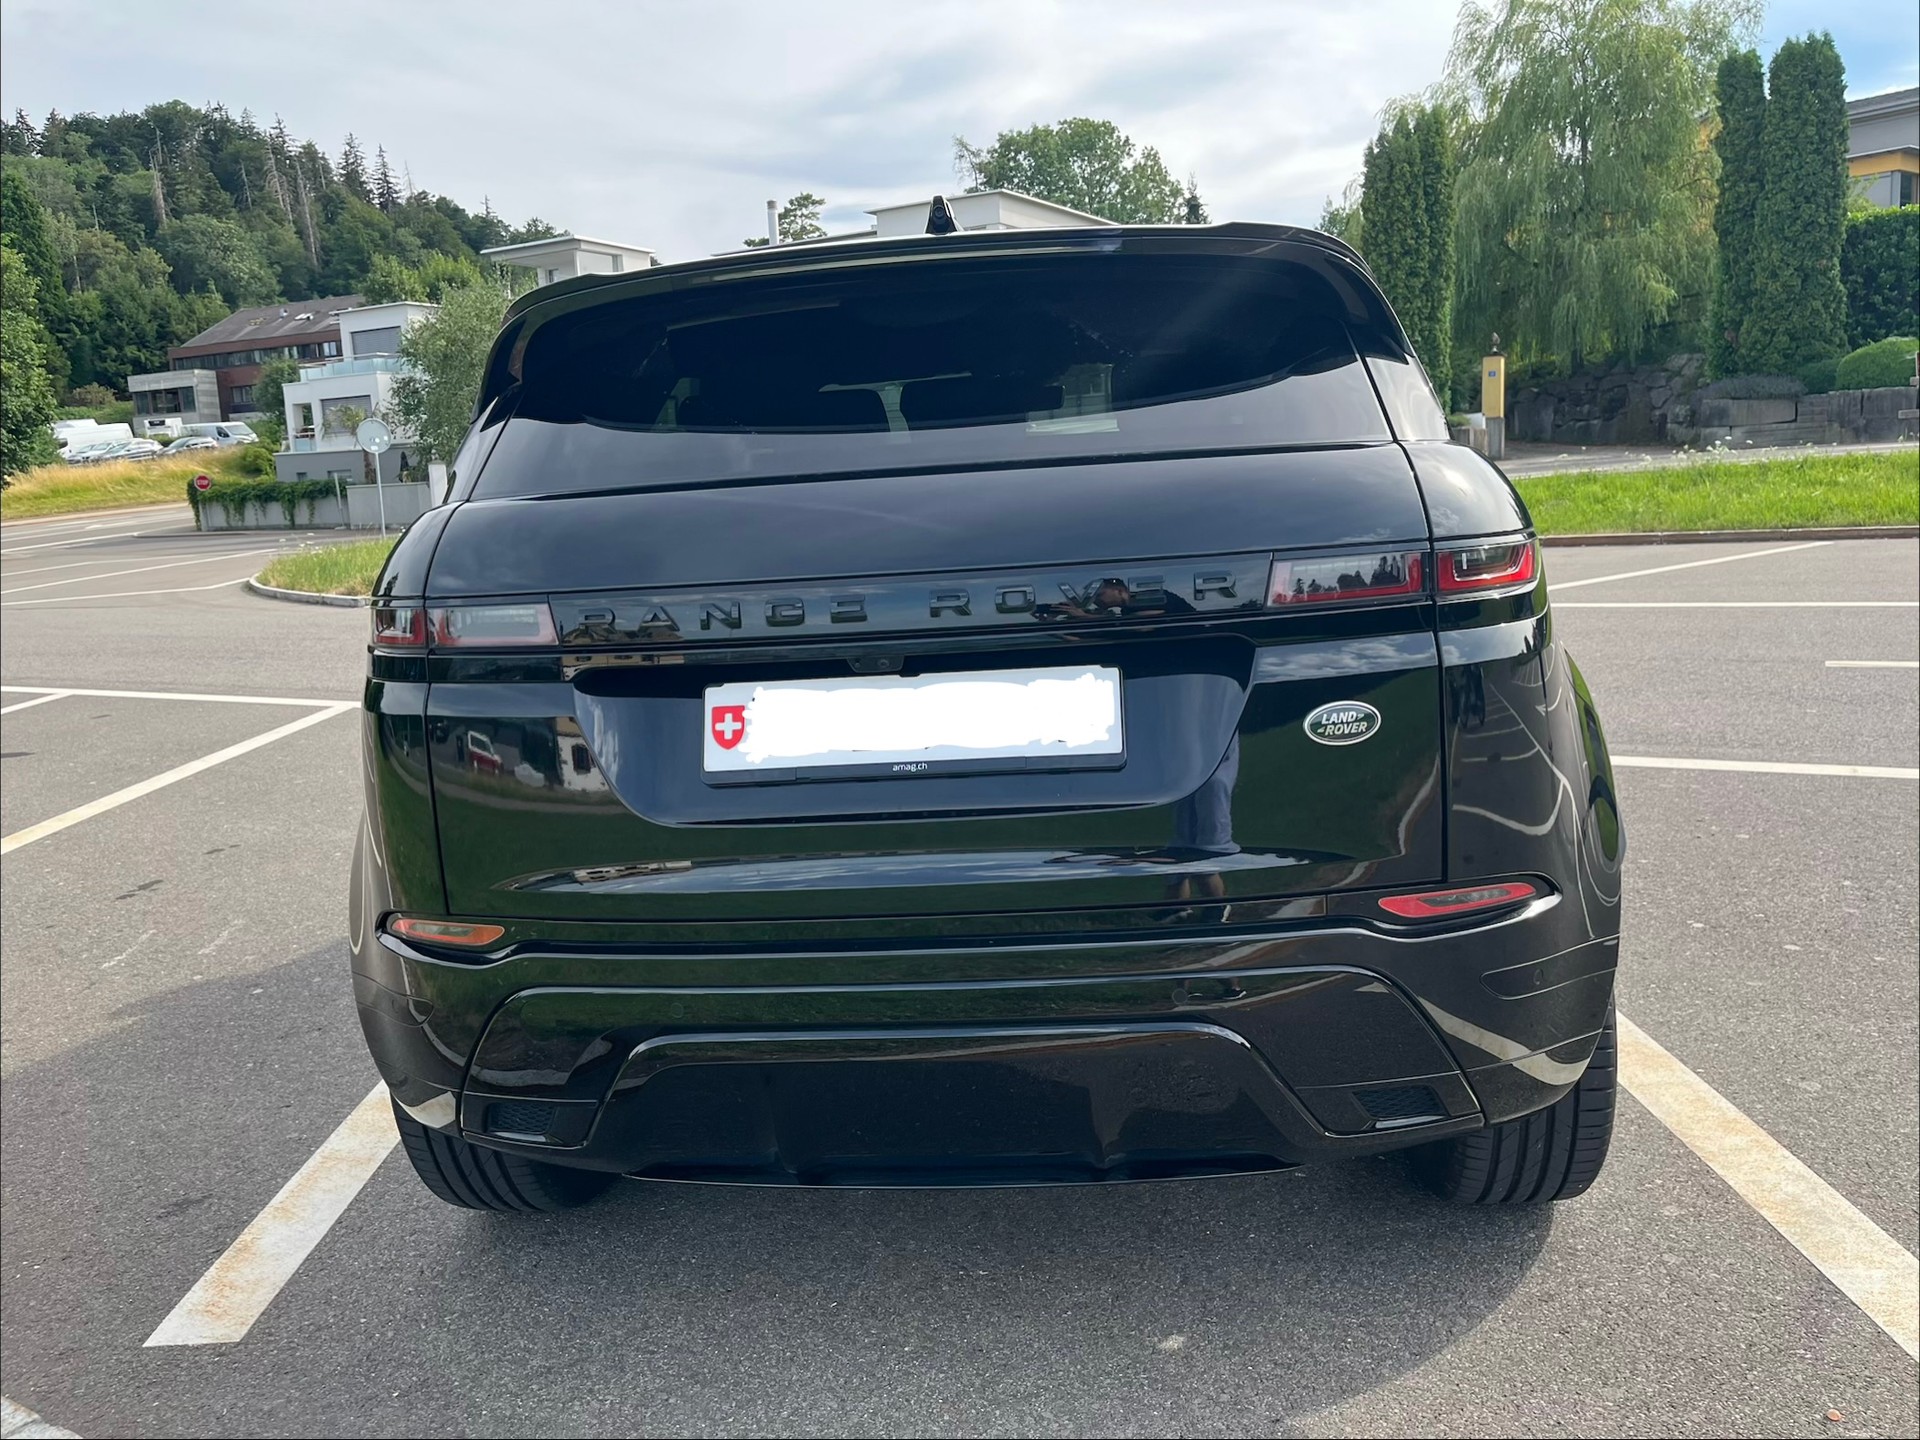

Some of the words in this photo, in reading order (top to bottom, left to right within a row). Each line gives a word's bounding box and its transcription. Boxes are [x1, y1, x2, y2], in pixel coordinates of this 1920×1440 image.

[577, 594, 868, 635] RANGE
[928, 570, 1239, 618] ROVER
[1321, 711, 1357, 725] LAND
[1324, 721, 1368, 736] ROVER
[892, 762, 928, 772] amag.ch
